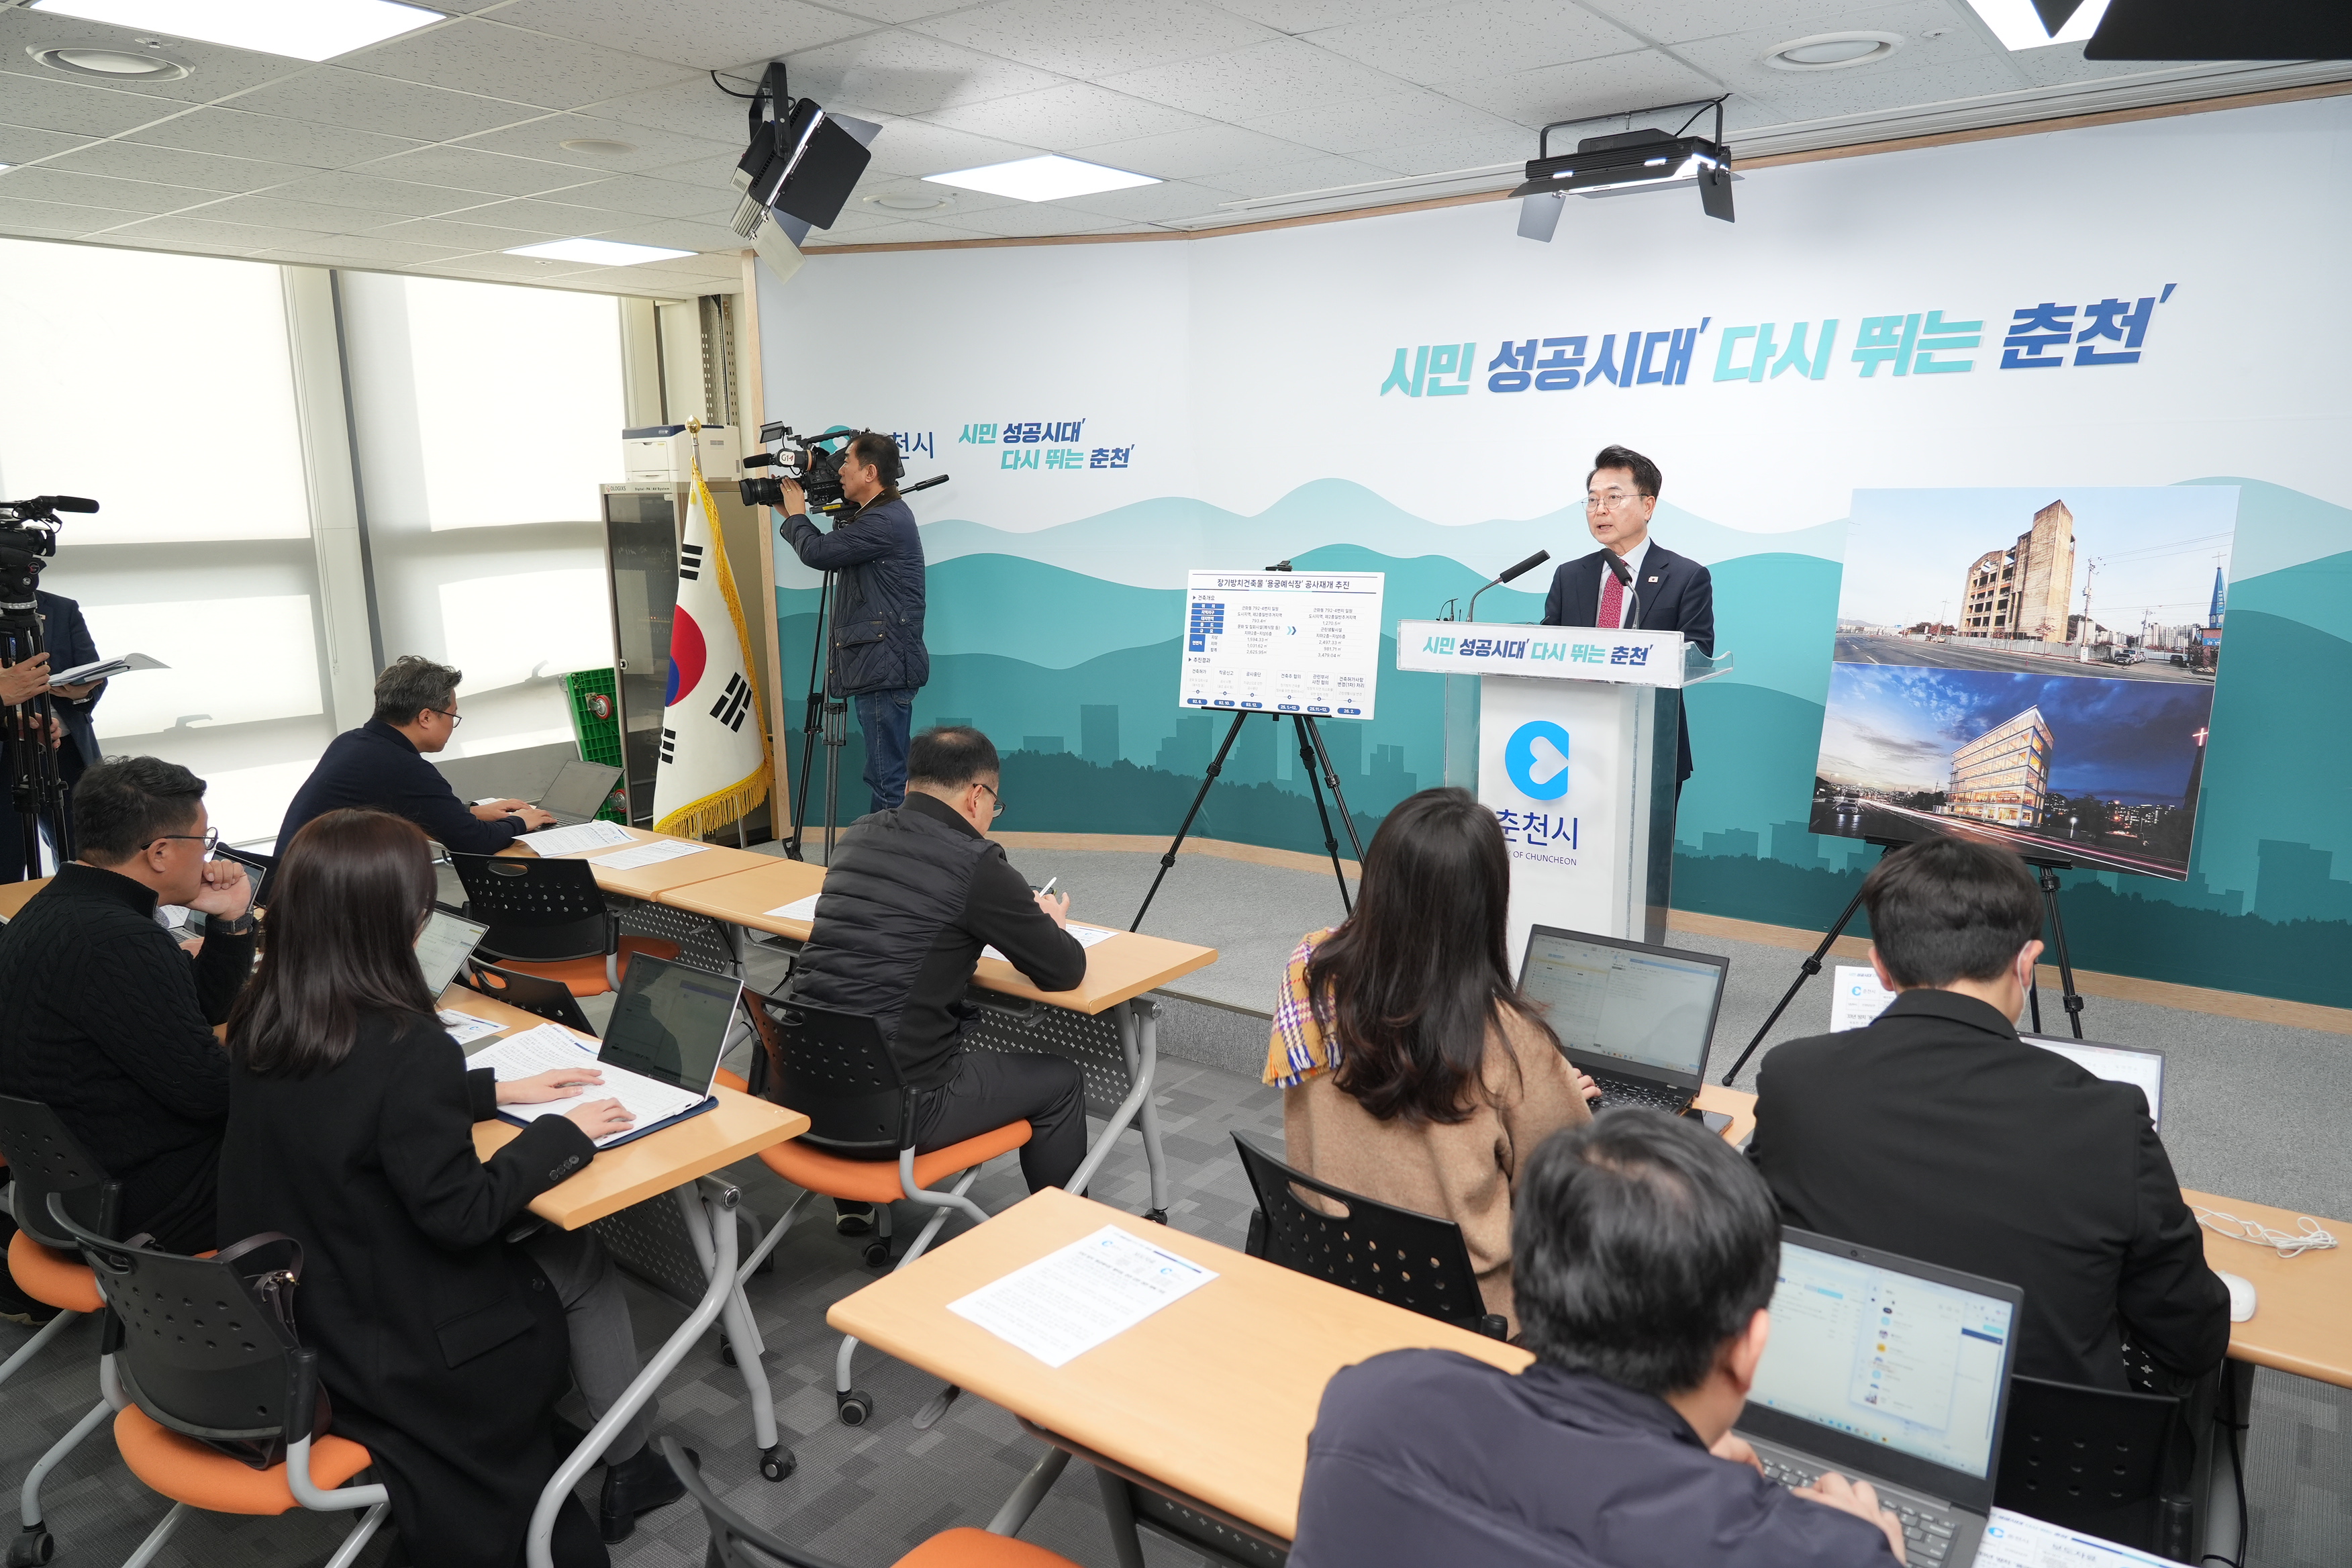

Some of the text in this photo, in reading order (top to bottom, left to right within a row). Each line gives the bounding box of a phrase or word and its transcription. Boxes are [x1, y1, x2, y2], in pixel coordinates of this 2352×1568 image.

[1380, 342, 1477, 397] 시민
[1713, 319, 1839, 382] 다시
[1851, 309, 1983, 377] 뛰는
[894, 432, 934, 459] 천시
[959, 423, 997, 444] 시민
[1001, 448, 1040, 470] 다시
[1045, 448, 1084, 469] 뛰는
[1217, 579, 1263, 587] 장기방치건축물
[1305, 581, 1334, 589] 공사재개
[1335, 581, 1350, 589] 추진
[1422, 636, 1455, 654] 시민
[1530, 642, 1566, 661] 다시
[1570, 644, 1606, 664] 뛰는
[1496, 809, 1578, 850] 춘천시
[1525, 852, 1577, 866] CHUNCHEON
